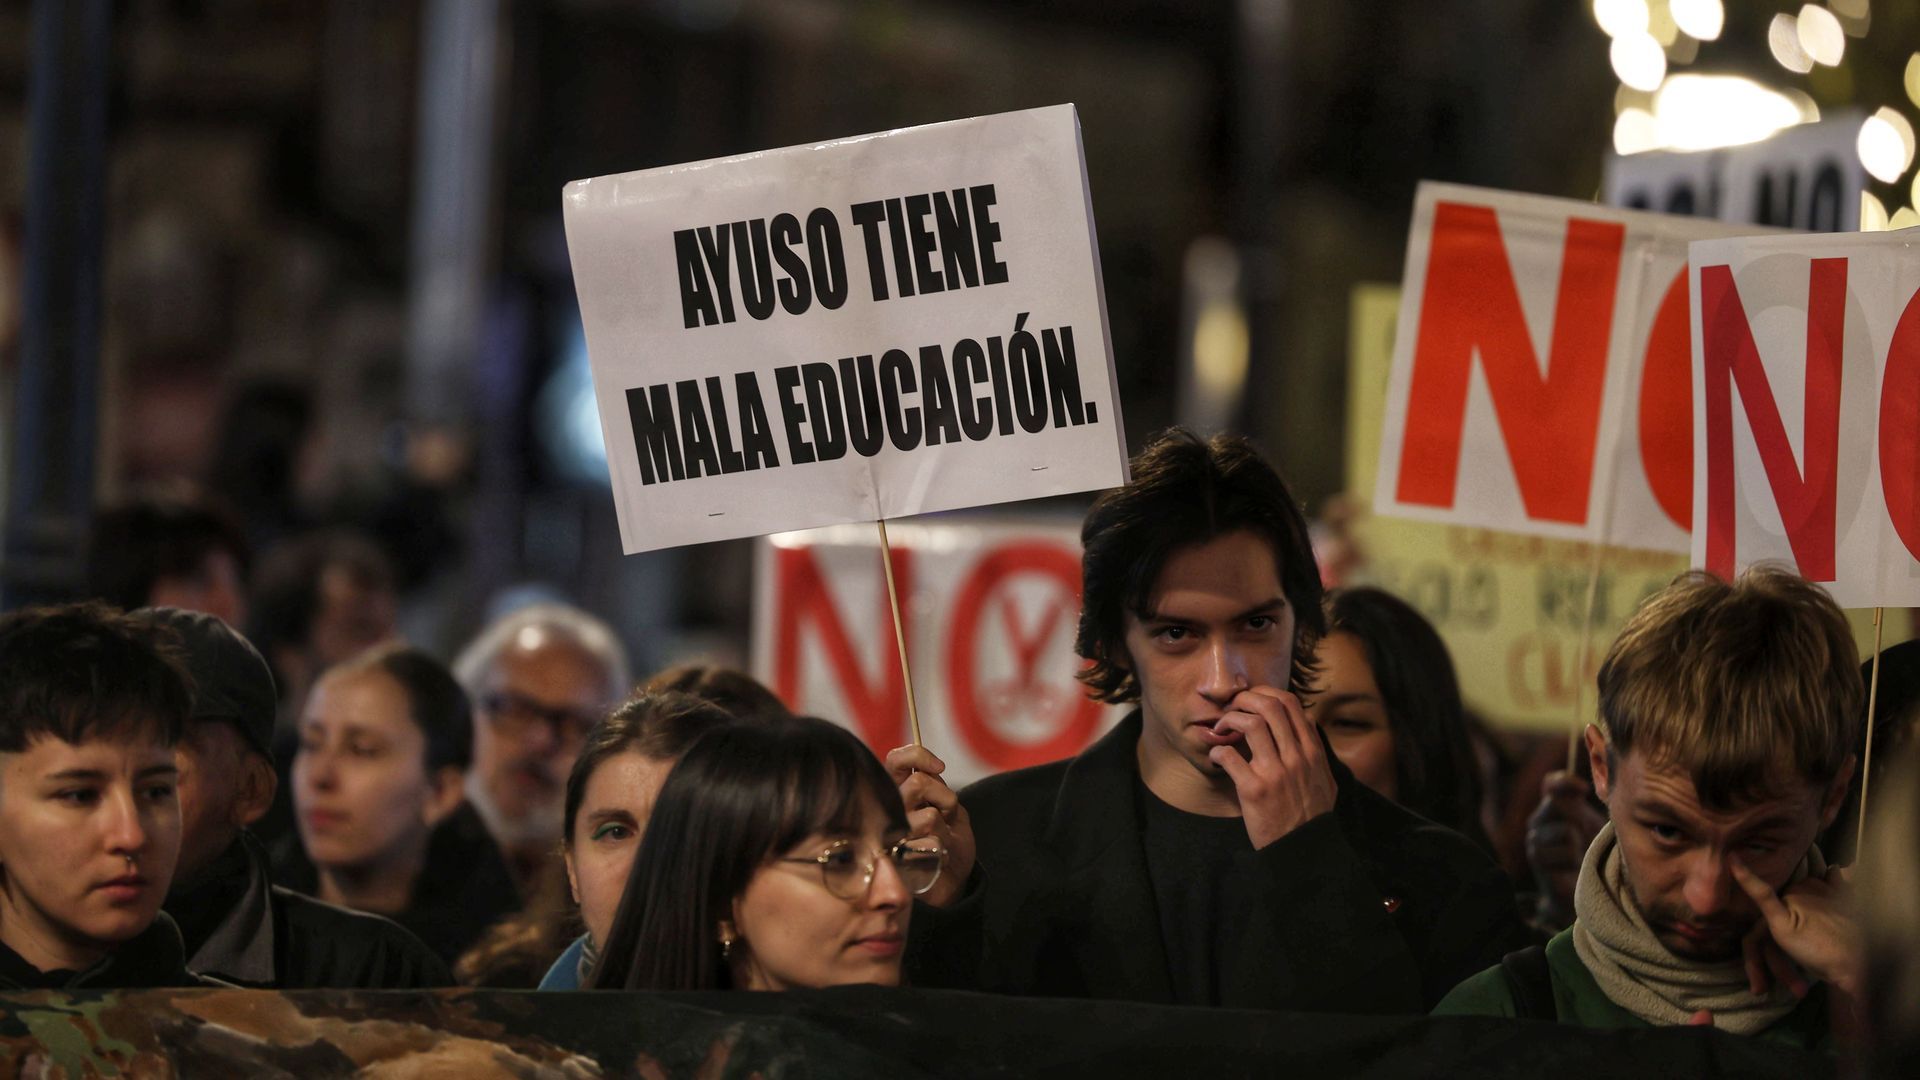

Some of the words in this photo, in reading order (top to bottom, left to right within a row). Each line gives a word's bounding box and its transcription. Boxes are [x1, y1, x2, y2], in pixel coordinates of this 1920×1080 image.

[673, 207, 848, 329] AYUSO
[850, 183, 1009, 302] TIENE
[1395, 200, 1694, 535] N
[625, 370, 780, 486] MALA
[774, 312, 1099, 465] EDUCACIÓN.
[1700, 256, 1920, 583] N
[775, 540, 1106, 773] NO
